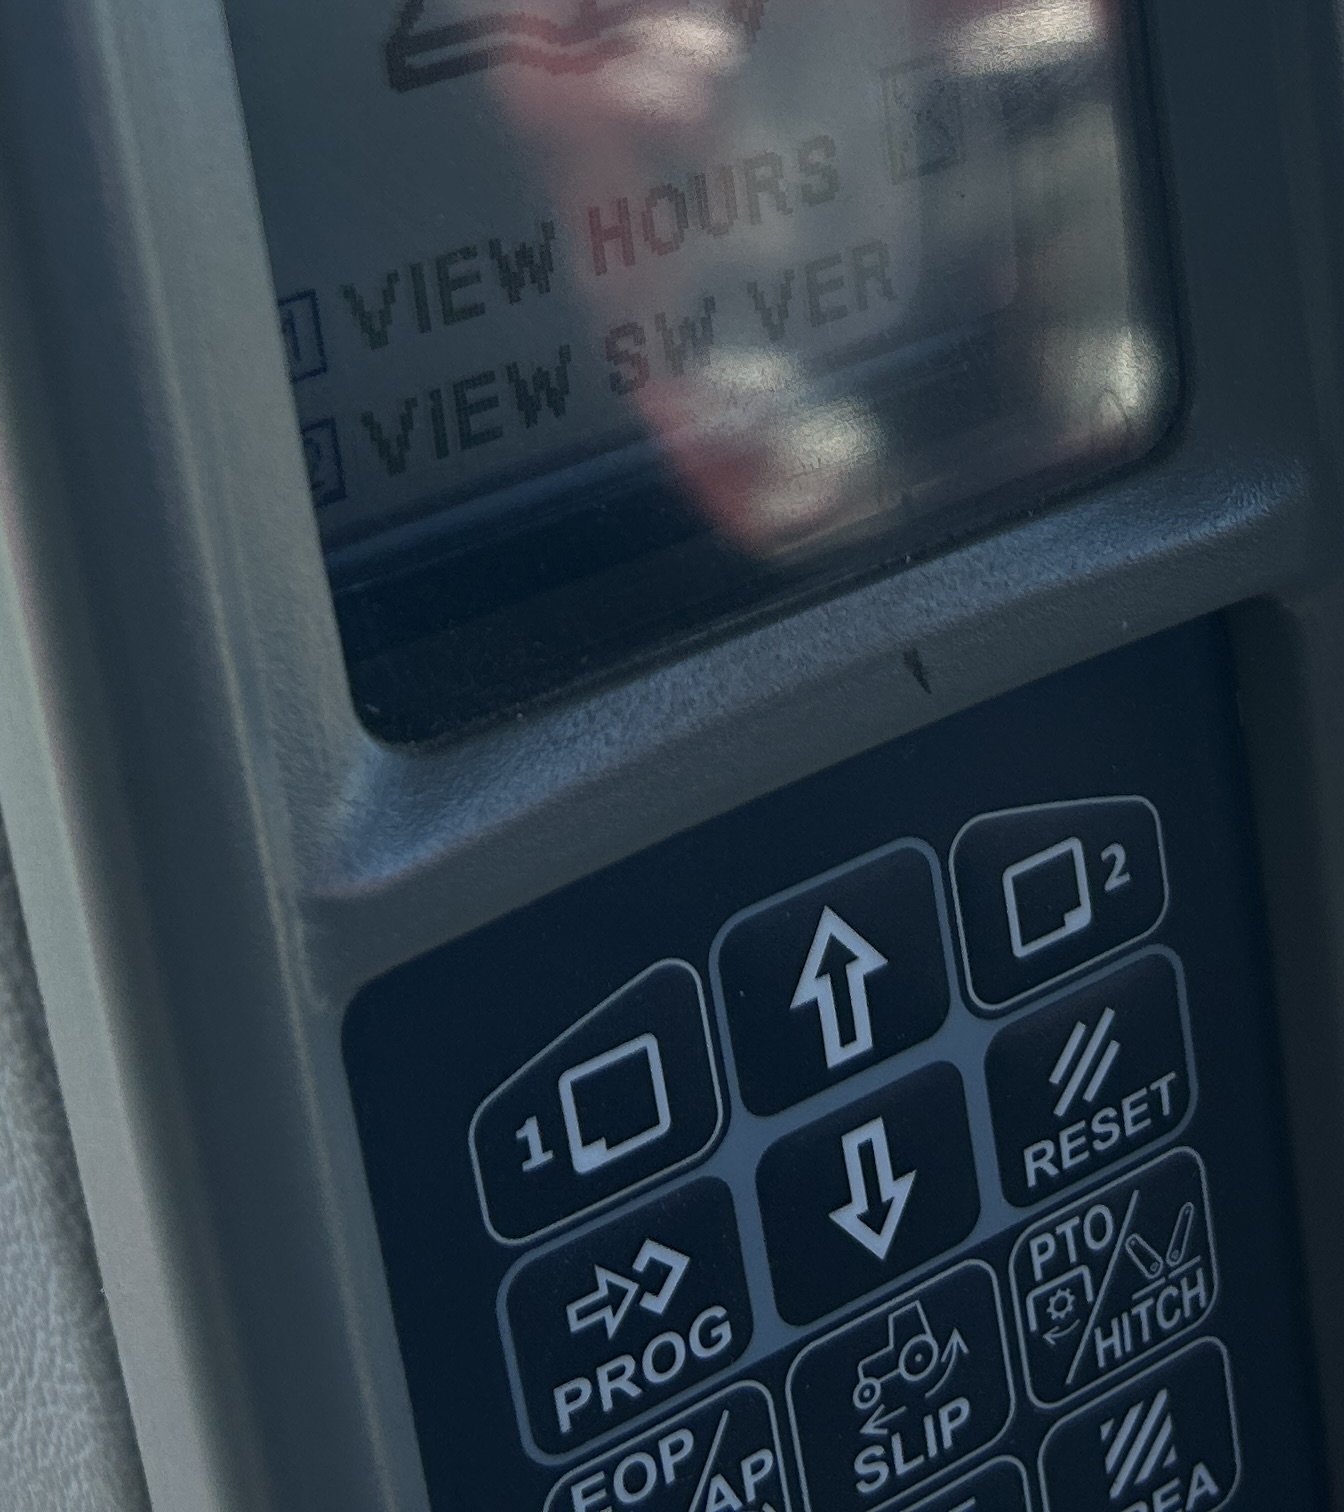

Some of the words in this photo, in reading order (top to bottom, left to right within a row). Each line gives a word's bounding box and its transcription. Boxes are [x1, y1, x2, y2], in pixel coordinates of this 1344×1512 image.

[340, 219, 556, 351] VIEW
[587, 133, 841, 276] HOURS
[360, 343, 573, 476] VIEW
[603, 295, 718, 394] SW
[745, 237, 902, 343] VER
[1099, 842, 1132, 892] 2
[513, 1114, 555, 1173] 1
[1022, 1071, 1181, 1188] RESET
[1029, 1203, 1115, 1281] PTO
[1093, 1268, 1209, 1368] HITCH
[553, 1304, 733, 1433] PROG
[853, 1396, 971, 1494] SLIP
